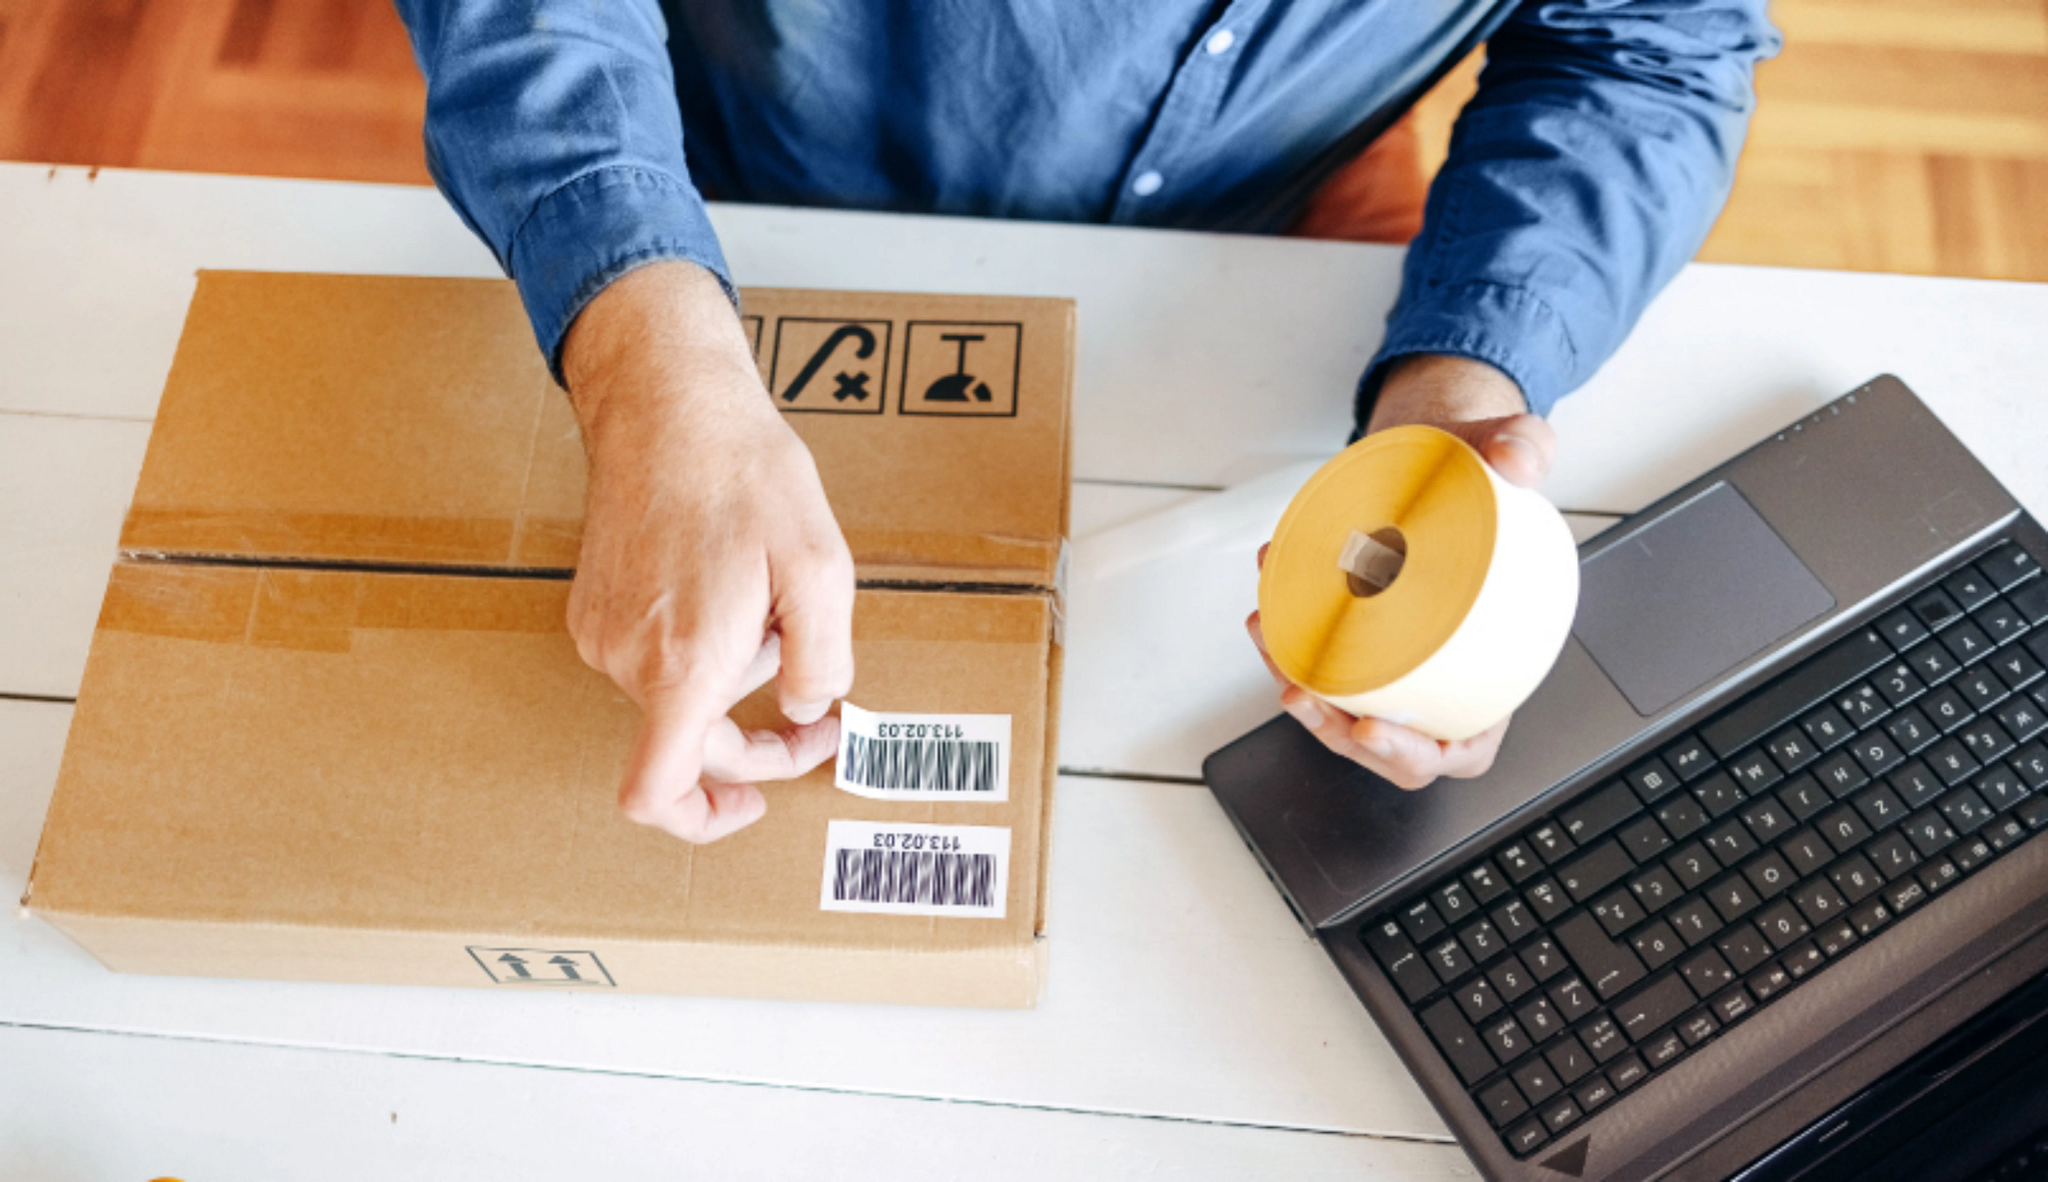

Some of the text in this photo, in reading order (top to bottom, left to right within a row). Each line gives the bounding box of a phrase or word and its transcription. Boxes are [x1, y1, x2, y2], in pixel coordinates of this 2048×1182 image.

[1963, 637, 1976, 650] Y
[1925, 656, 1941, 671] X
[2007, 659, 2021, 674] A
[1891, 677, 1907, 693] C
[1975, 681, 1989, 695] S
[1859, 700, 1873, 714] V
[1940, 701, 1955, 716] D
[2016, 711, 2033, 727] W
[878, 723, 964, 738] 113.02.03
[1821, 721, 1835, 735] B
[1981, 733, 1995, 748] E
[1785, 741, 1801, 758] N
[1869, 746, 1885, 761] G
[1747, 763, 1764, 780] M
[1833, 767, 1849, 783] H
[1913, 777, 1925, 792] T
[1995, 782, 2006, 795] 4
[1873, 799, 1889, 815] Z
[1960, 803, 1973, 818] 5
[1760, 812, 1775, 827] K
[1838, 821, 1853, 837] U
[1924, 825, 1935, 840] 6
[873, 833, 961, 851] 113.02.03
[1891, 848, 1902, 865] 7
[1851, 871, 1865, 886] 8
[1816, 895, 1829, 909] 9
[1475, 933, 1488, 947] 2
[1538, 954, 1547, 966] 4
[1505, 972, 1517, 987] 5
[1473, 993, 1483, 1007] 6
[1571, 992, 1581, 1006] 7
[1535, 1013, 1547, 1026] 8
[1503, 1033, 1514, 1049] 9
